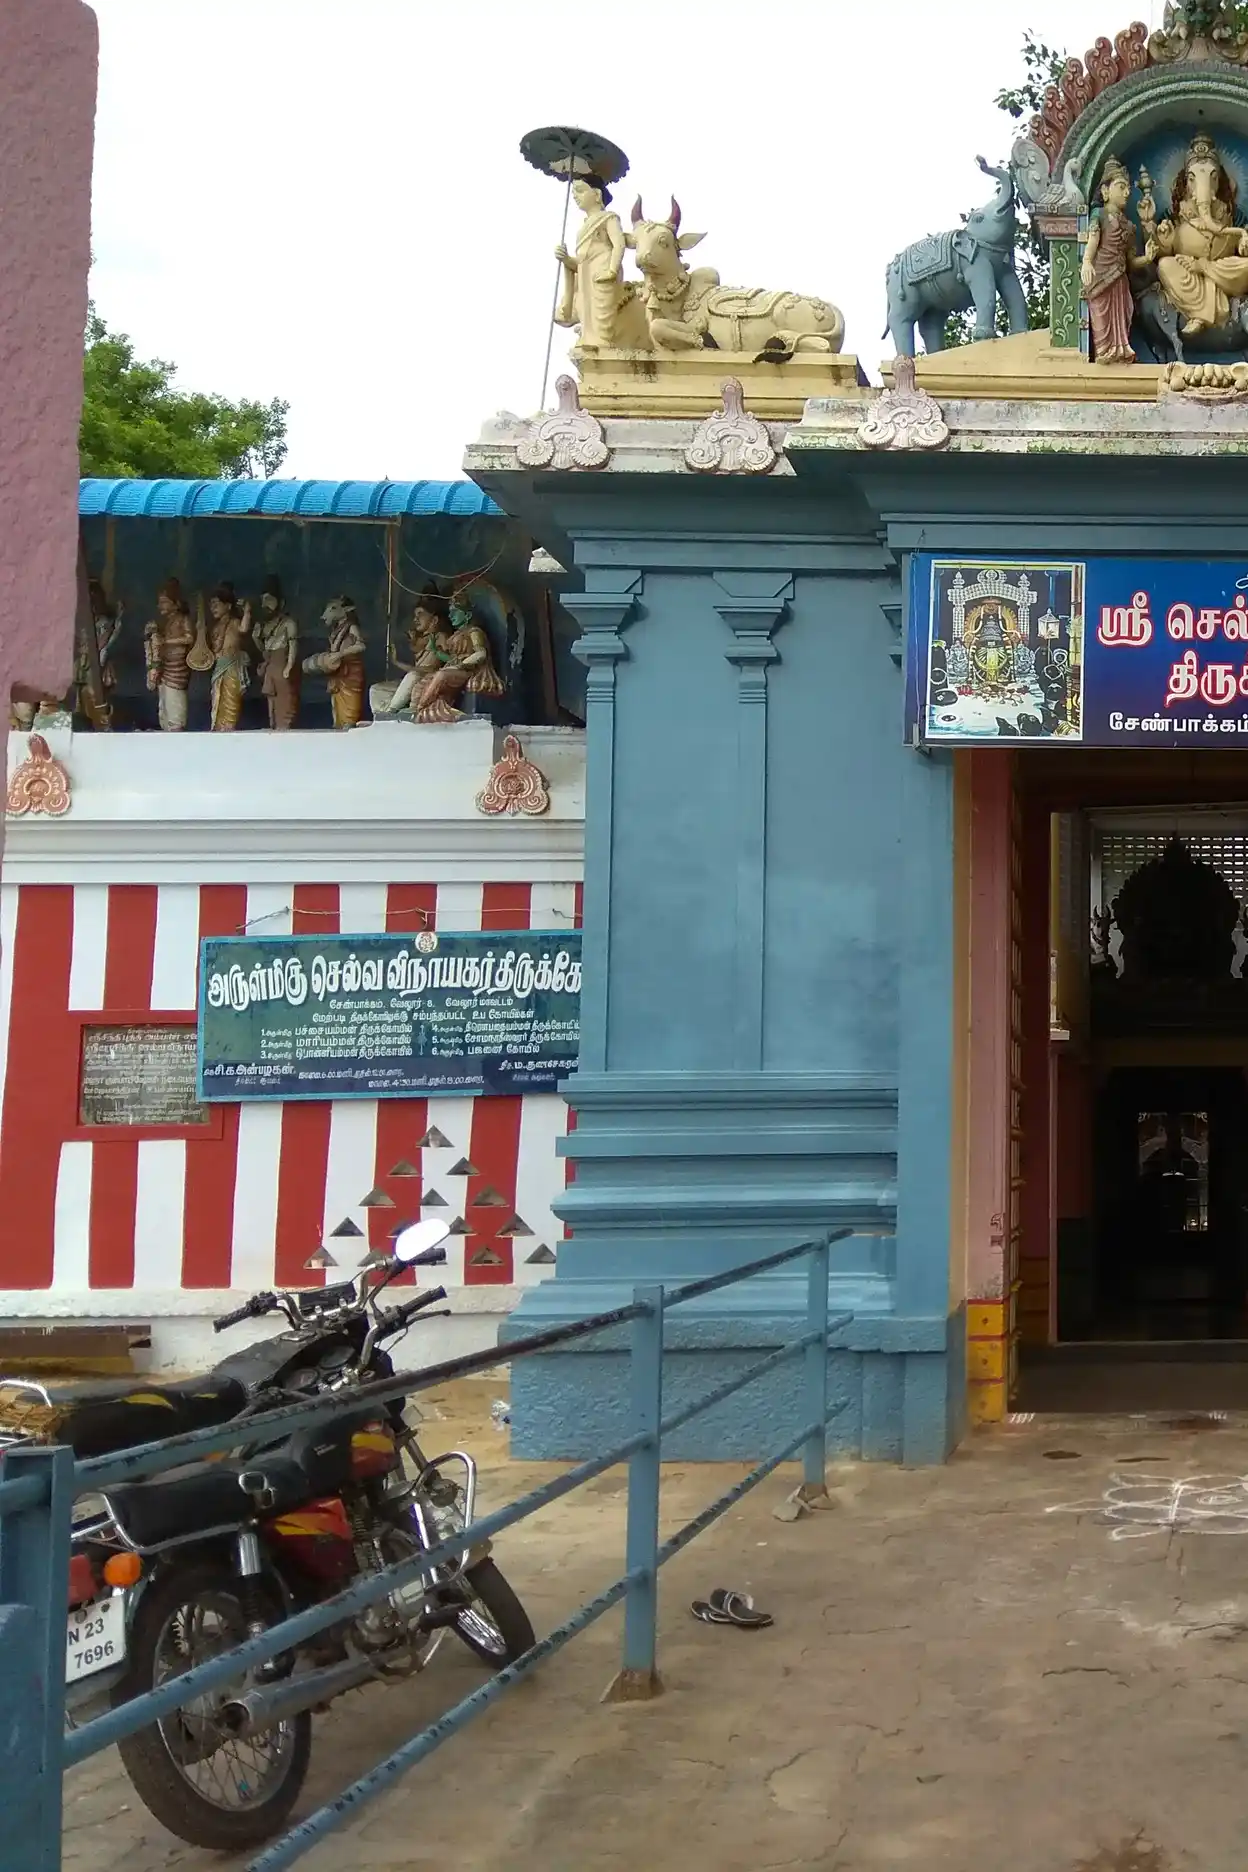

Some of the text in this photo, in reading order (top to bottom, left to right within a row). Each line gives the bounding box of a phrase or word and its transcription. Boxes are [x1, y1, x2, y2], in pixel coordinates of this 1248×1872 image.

[207, 957, 309, 1012] அருள்மிகு
[311, 953, 384, 1002] செல்வ
[85, 1616, 105, 1640] 23
[74, 1640, 115, 1669] 7696
